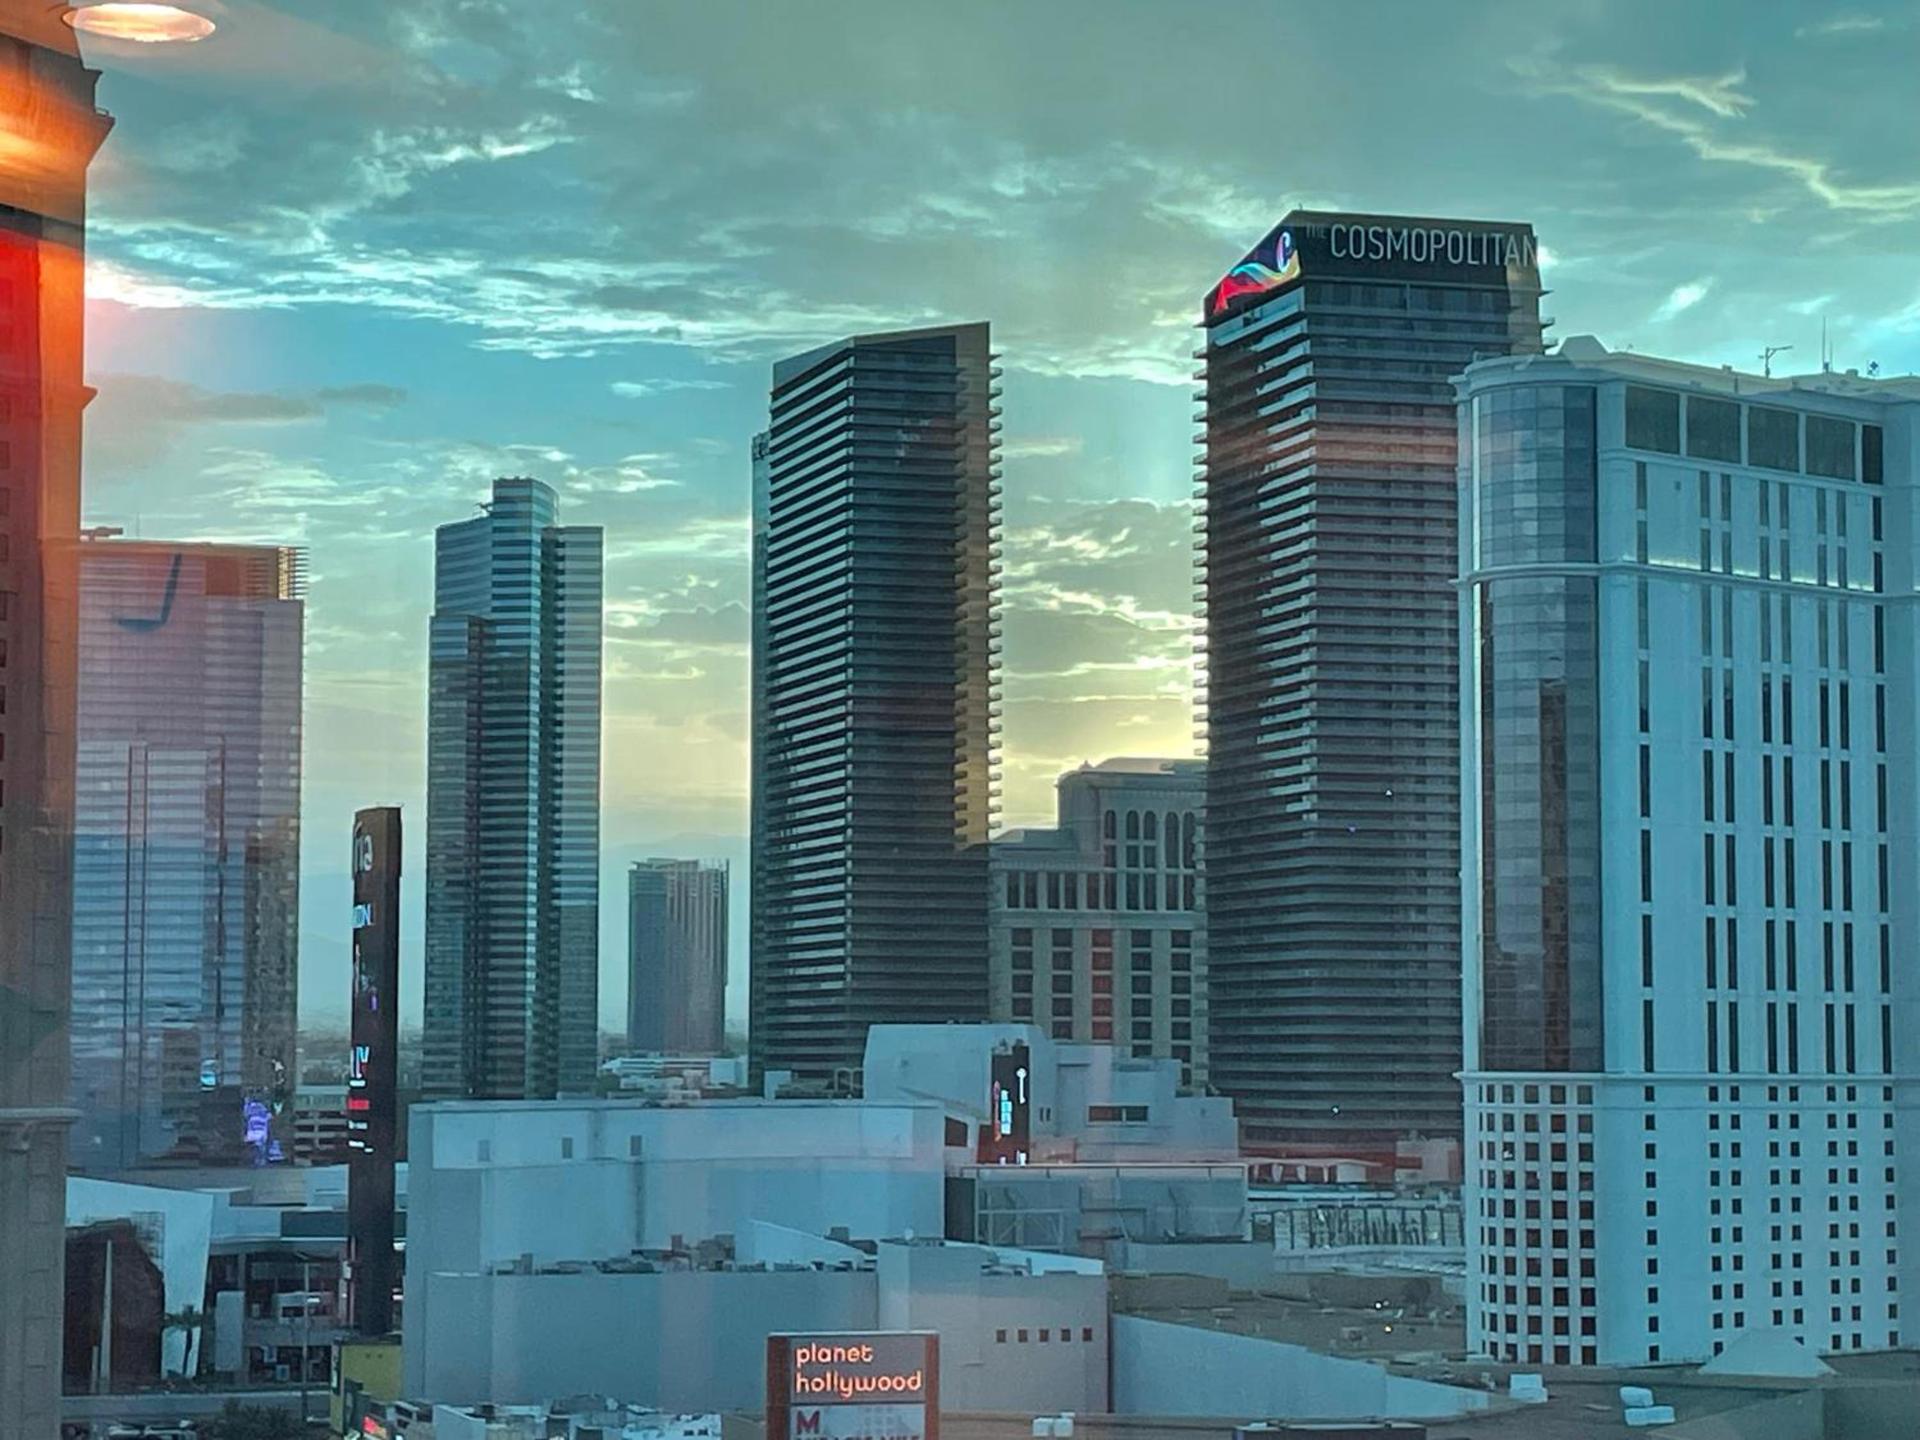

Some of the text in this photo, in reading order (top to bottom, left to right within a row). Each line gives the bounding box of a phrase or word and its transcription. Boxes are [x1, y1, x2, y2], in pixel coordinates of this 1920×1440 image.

[1331, 224, 1537, 268] COSMOPOLITAN
[796, 1342, 873, 1367] planet
[796, 1370, 922, 1399] hollywood
[796, 1410, 820, 1435] M
